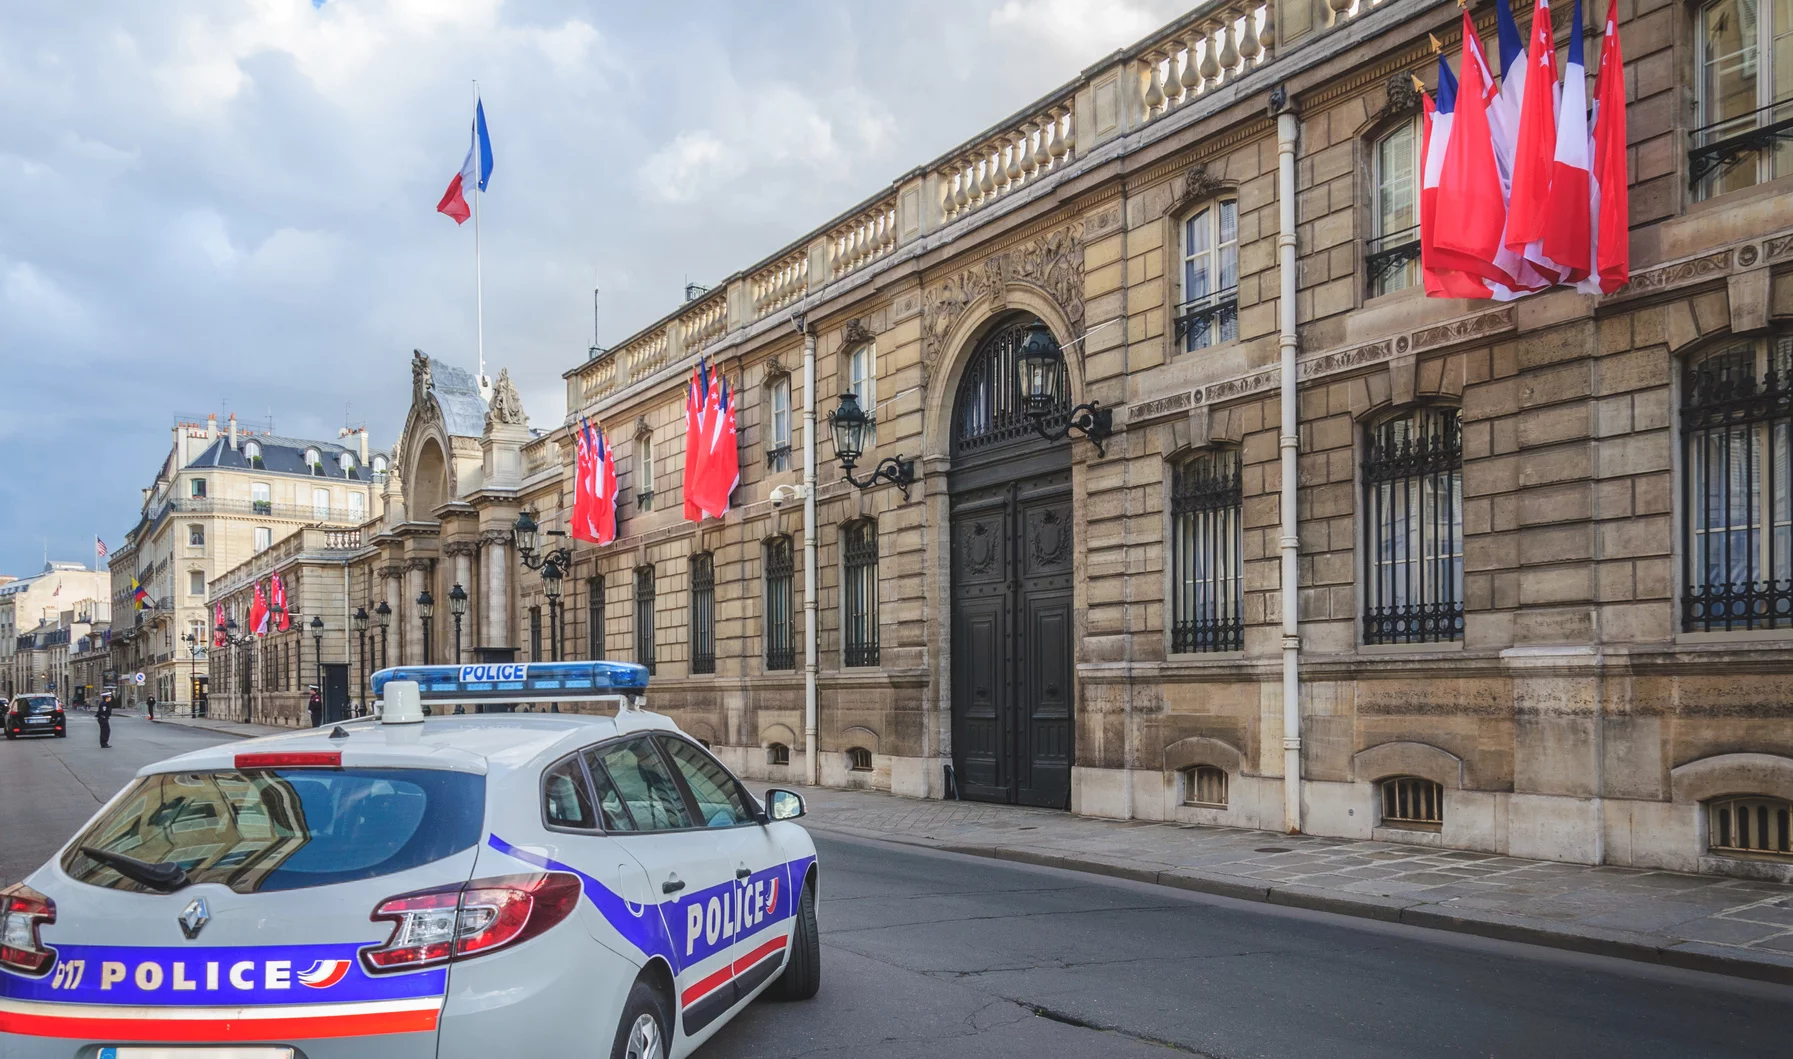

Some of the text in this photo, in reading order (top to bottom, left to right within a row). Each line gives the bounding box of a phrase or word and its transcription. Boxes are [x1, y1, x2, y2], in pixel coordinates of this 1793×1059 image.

[462, 664, 526, 681] POLICE
[686, 880, 764, 957] POLICE
[101, 961, 292, 990] POLICE
